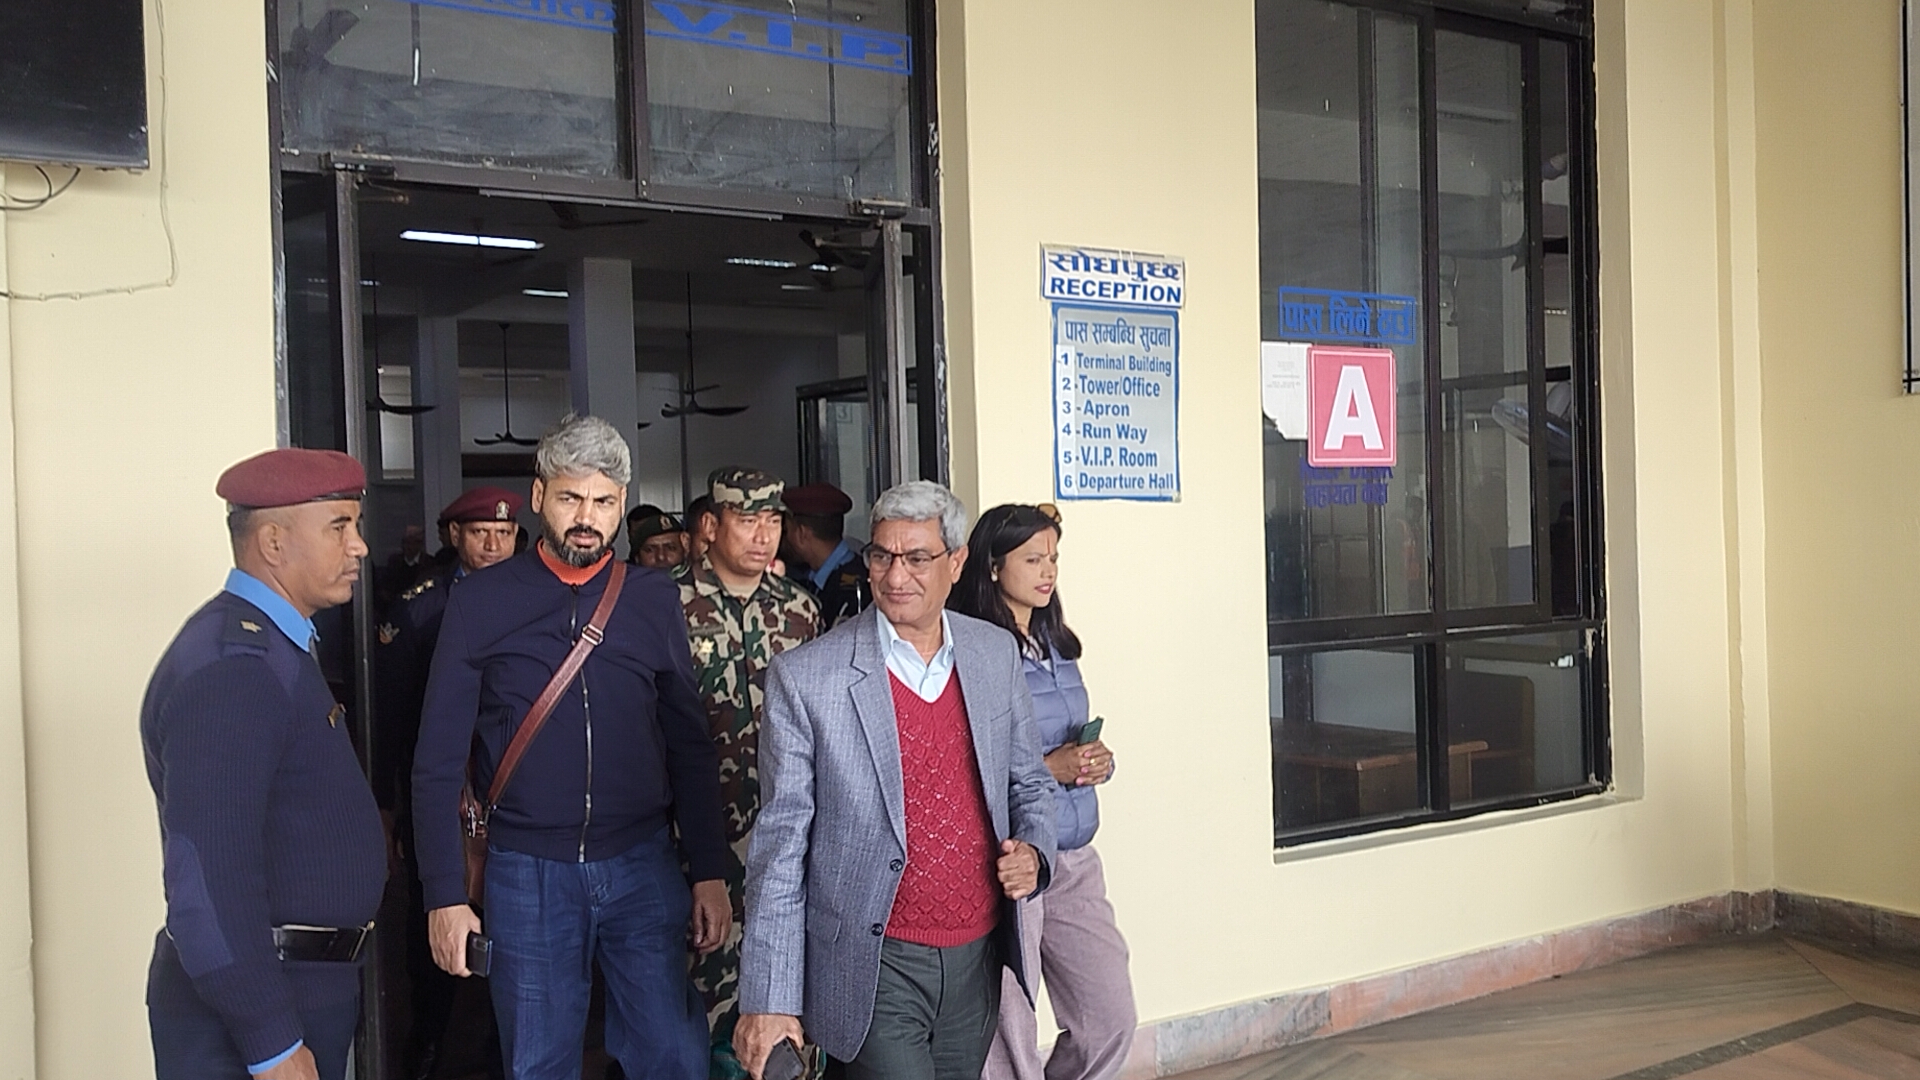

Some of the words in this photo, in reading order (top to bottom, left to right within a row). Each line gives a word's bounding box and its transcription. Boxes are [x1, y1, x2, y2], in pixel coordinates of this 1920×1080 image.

[651, 2, 904, 66] V.I.P.
[1051, 277, 1181, 302] RECEPTION
[1065, 320, 1088, 343] पास
[1139, 326, 1172, 352] सुचना
[1061, 353, 1069, 365] 1
[1077, 352, 1125, 370] Terminal
[1129, 355, 1172, 377] Building
[1062, 377, 1071, 391] 2
[1062, 401, 1071, 414] 3
[1323, 364, 1385, 450] A
[1062, 423, 1071, 436] 4
[1116, 423, 1147, 444] Way
[1063, 451, 1072, 464] 5
[1119, 447, 1158, 467] Room
[1064, 475, 1072, 488] 6
[1079, 472, 1145, 492] Departure
[1149, 473, 1174, 489] Hall
